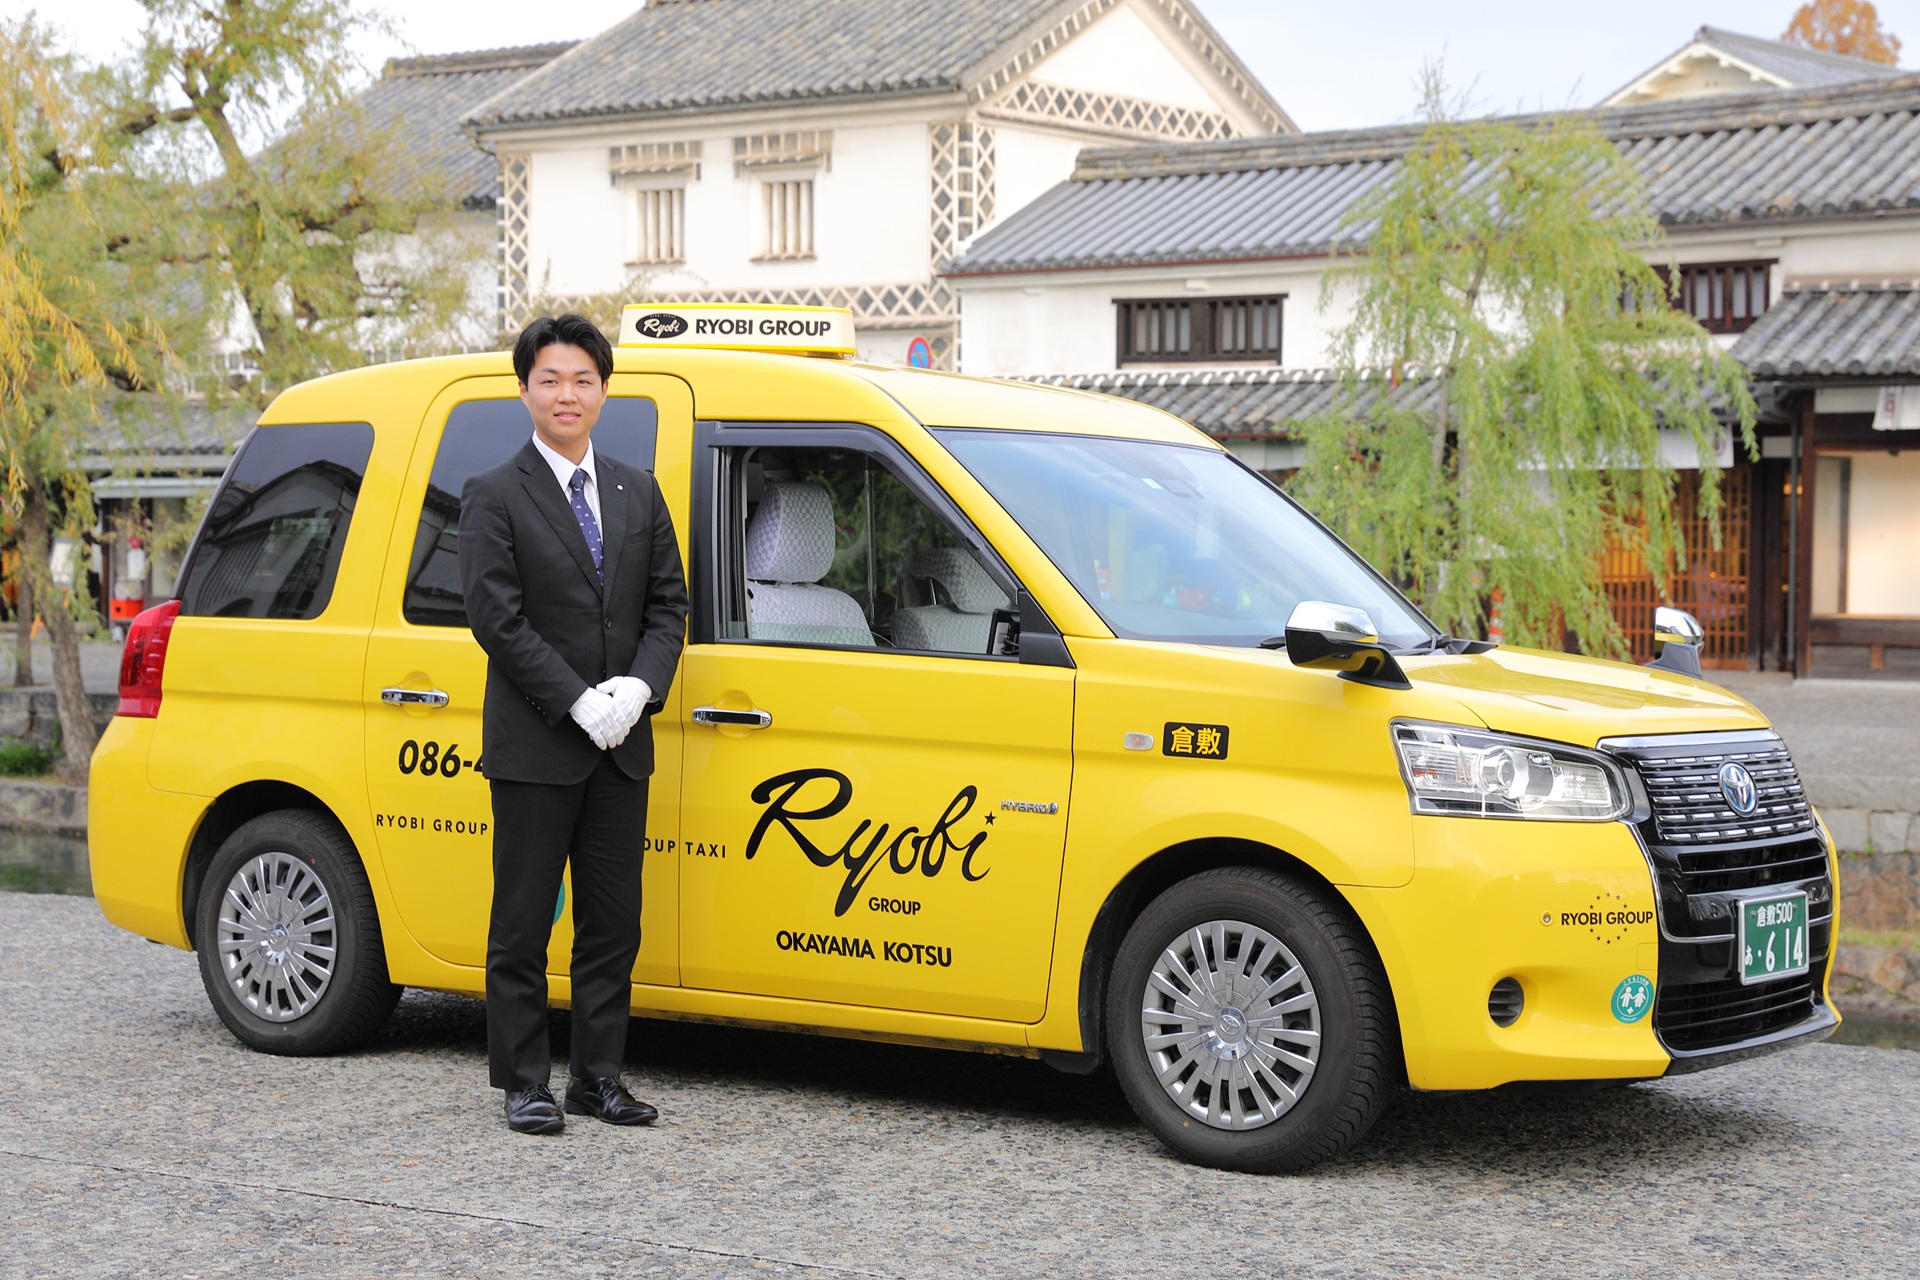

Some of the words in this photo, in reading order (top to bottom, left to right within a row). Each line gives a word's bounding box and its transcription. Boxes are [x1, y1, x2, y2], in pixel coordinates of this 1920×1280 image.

[643, 318, 681, 338] Ryobi
[695, 319, 753, 335] RYOBI
[759, 319, 831, 336] GROUP
[1170, 725, 1222, 756] 倉敷
[1001, 799, 1050, 815] HYBRID
[376, 813, 424, 830] RYOBI
[433, 818, 488, 835] GROUP
[643, 837, 676, 853] OUP
[685, 841, 726, 859] TAXI
[745, 768, 995, 918] Ryobi
[868, 896, 922, 916] GROUP
[1561, 911, 1602, 926] RYOBI
[1605, 910, 1653, 925] GROUP
[776, 930, 876, 960] OKAYAMA
[883, 941, 953, 968] KOTSU
